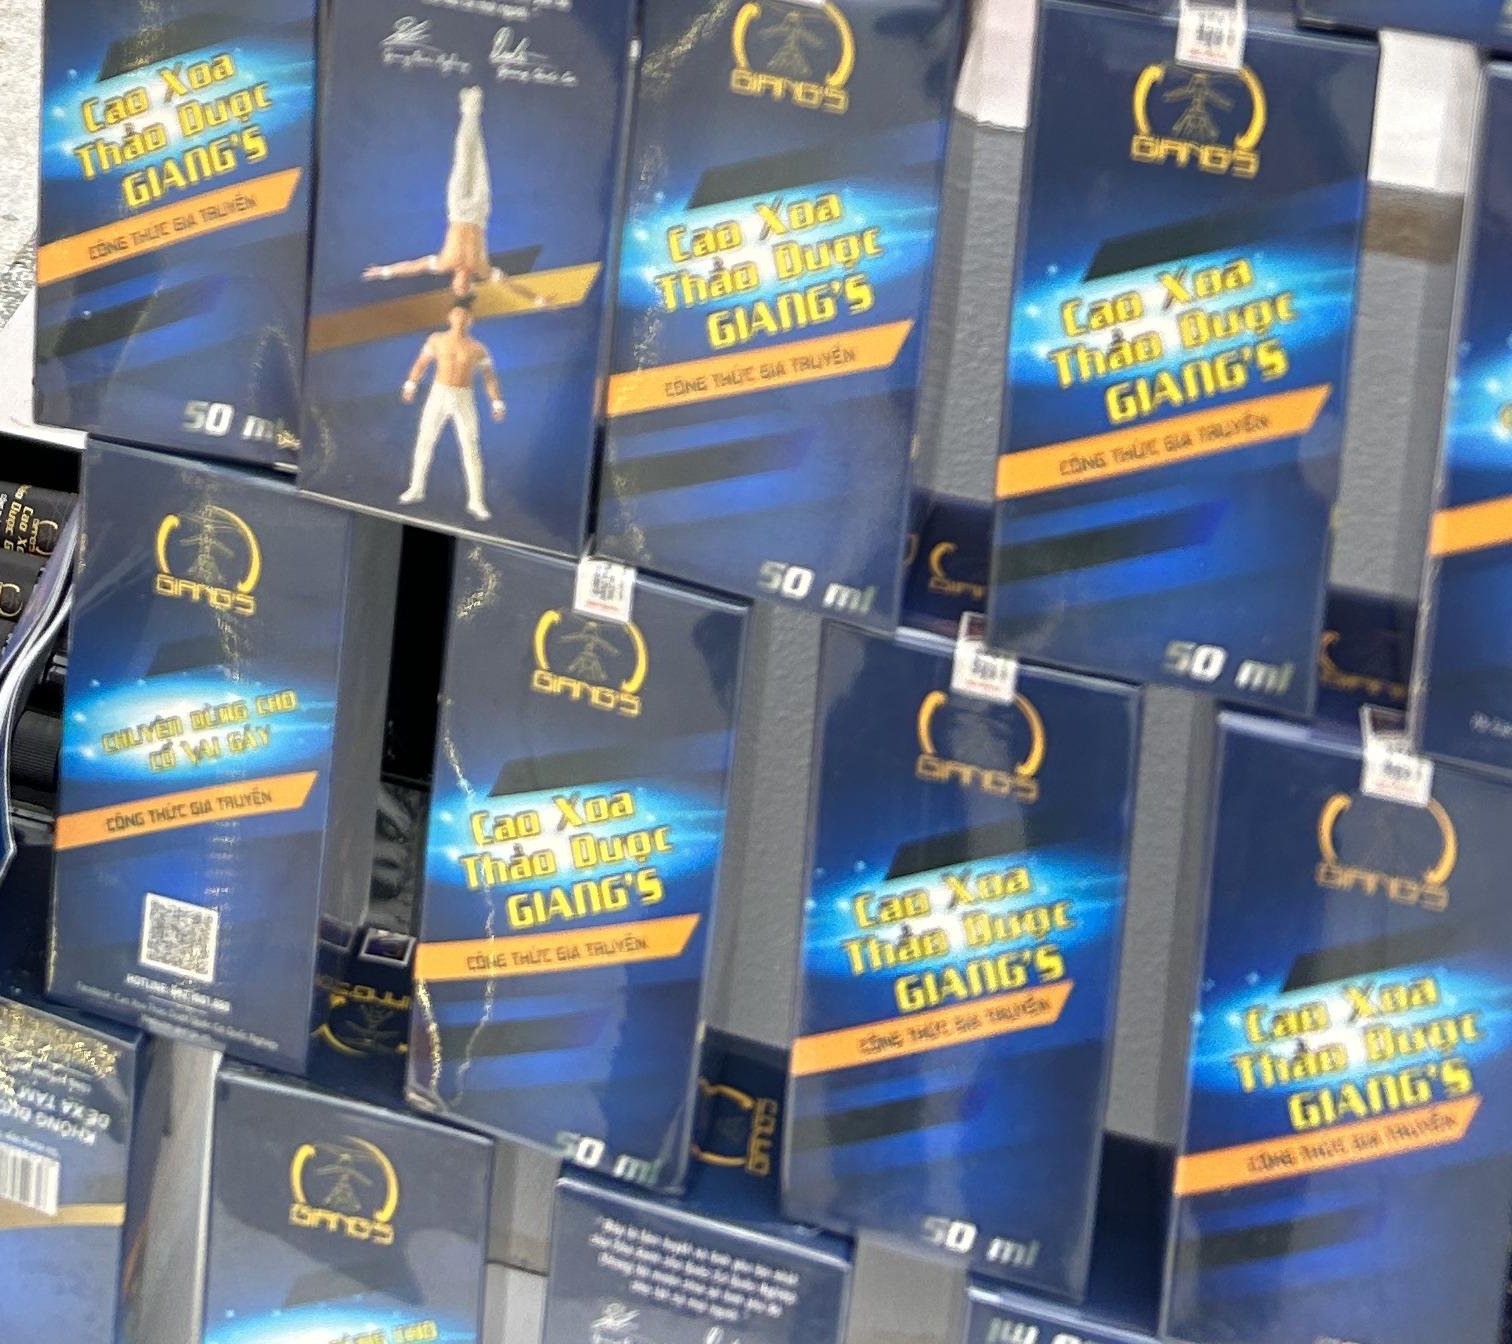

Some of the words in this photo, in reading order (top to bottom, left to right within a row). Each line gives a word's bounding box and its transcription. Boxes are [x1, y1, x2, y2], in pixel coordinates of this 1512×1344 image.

[85, 86, 150, 133] Cao
[158, 51, 235, 102] Xoa
[76, 122, 167, 178] Thảo
[121, 122, 270, 209] GIANG'S
[666, 220, 742, 264] Cao
[754, 192, 843, 240] Xoa
[655, 257, 760, 311] Thảo
[705, 272, 875, 349] GIANG'S
[1063, 290, 1144, 338] Cao
[1157, 256, 1254, 309] Xoa
[1050, 329, 1164, 387] Thảo
[1104, 336, 1290, 423] GIANG'S
[181, 398, 234, 436] 50
[19, 506, 34, 532] Cao
[759, 561, 814, 599] 50
[822, 578, 876, 614] ml
[1165, 640, 1227, 684] 50
[1235, 654, 1296, 694] ml
[254, 689, 297, 716] CHO
[470, 810, 541, 847] Cao
[552, 791, 636, 830] Xoa
[459, 844, 557, 890] Thảo
[506, 868, 665, 929] GIANG'S
[853, 888, 931, 929] Cao
[893, 940, 1066, 1008] GIANG'S
[1247, 1002, 1331, 1044] Cao
[1290, 1049, 1475, 1127] GIANG'S
[556, 1131, 605, 1168] 50
[612, 1148, 662, 1184] ml
[922, 1217, 976, 1257] 50
[985, 1225, 1041, 1268] ml
